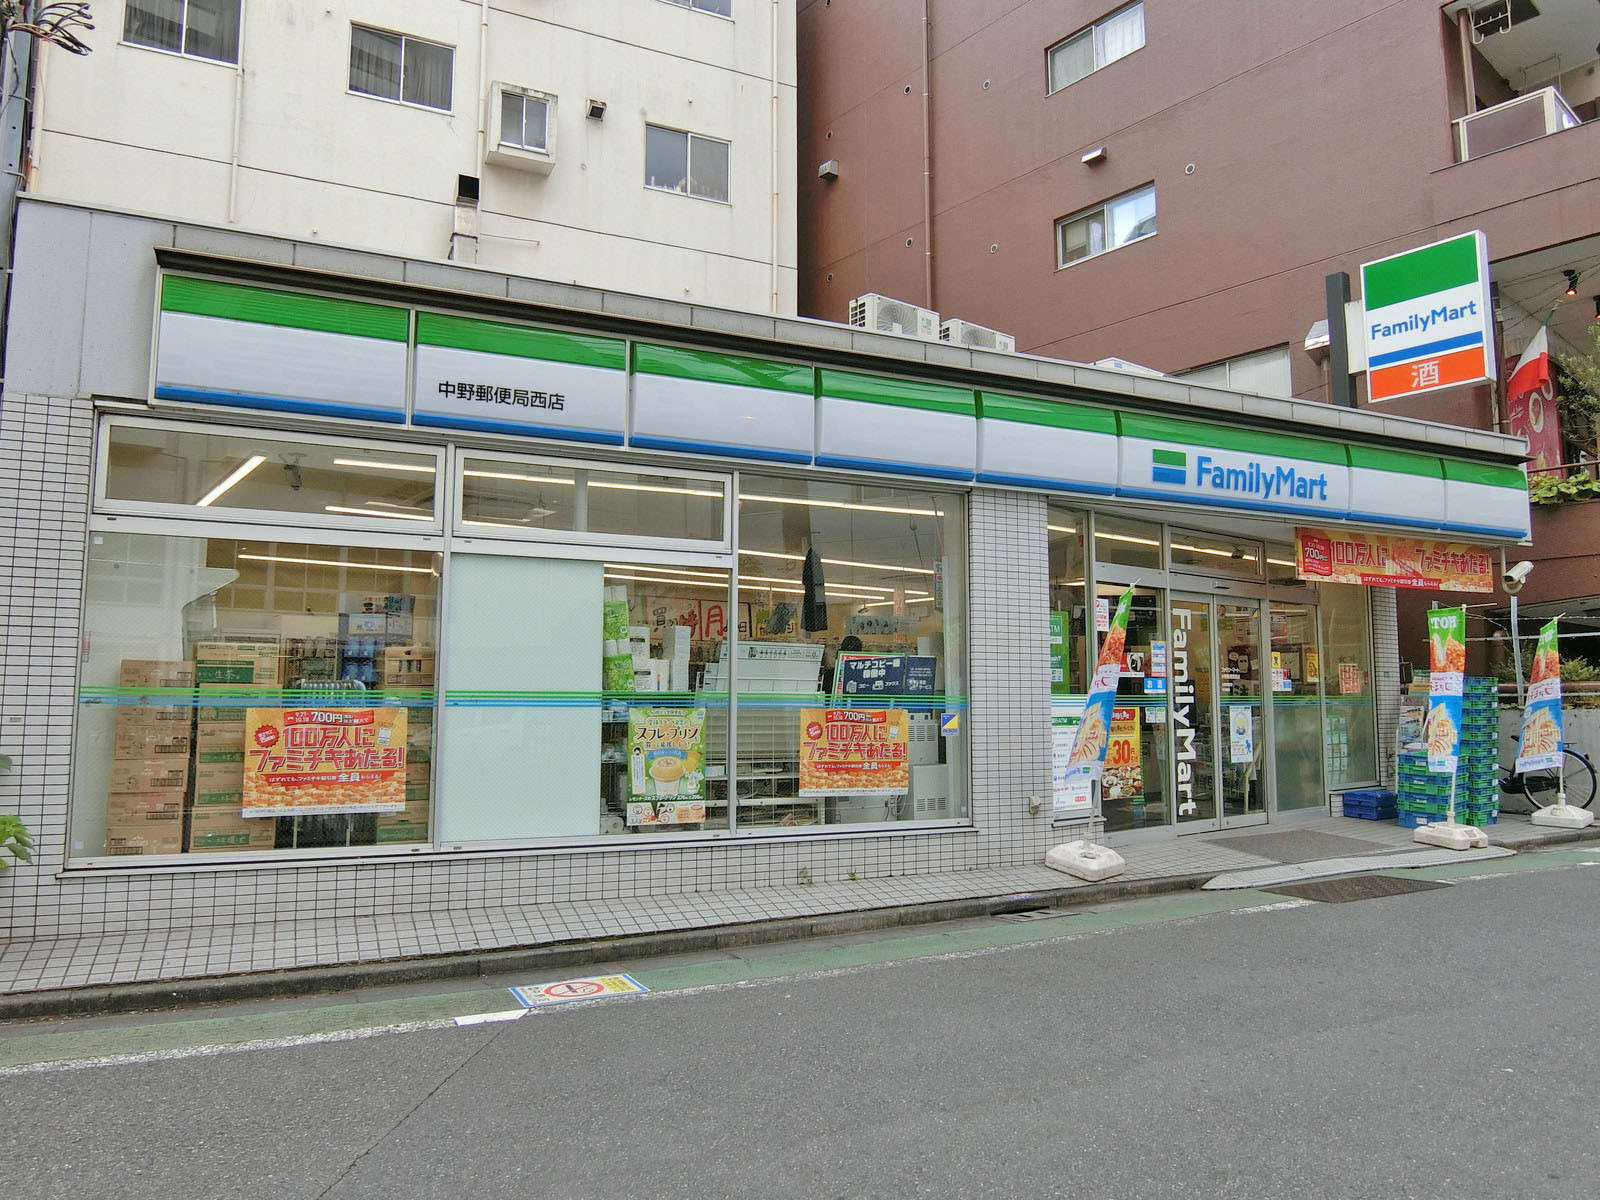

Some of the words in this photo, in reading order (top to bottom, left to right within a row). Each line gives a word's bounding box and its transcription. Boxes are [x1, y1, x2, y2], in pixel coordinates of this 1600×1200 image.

[1371, 300, 1476, 340] FamilyMart
[1411, 360, 1439, 388] 酒
[438, 380, 565, 411] 中野郵便局西店
[1197, 455, 1327, 501] FamilyMart
[1330, 540, 1389, 568] 100万人に
[1415, 548, 1489, 576] ファミチキあたる!
[311, 711, 343, 723] 700円
[1173, 608, 1197, 816] FamilyMart
[282, 726, 376, 749] 100万人に
[825, 724, 888, 742] 100万人に
[248, 746, 404, 772] ファミチキあたる!
[803, 741, 908, 761] ファミチキあたる!
